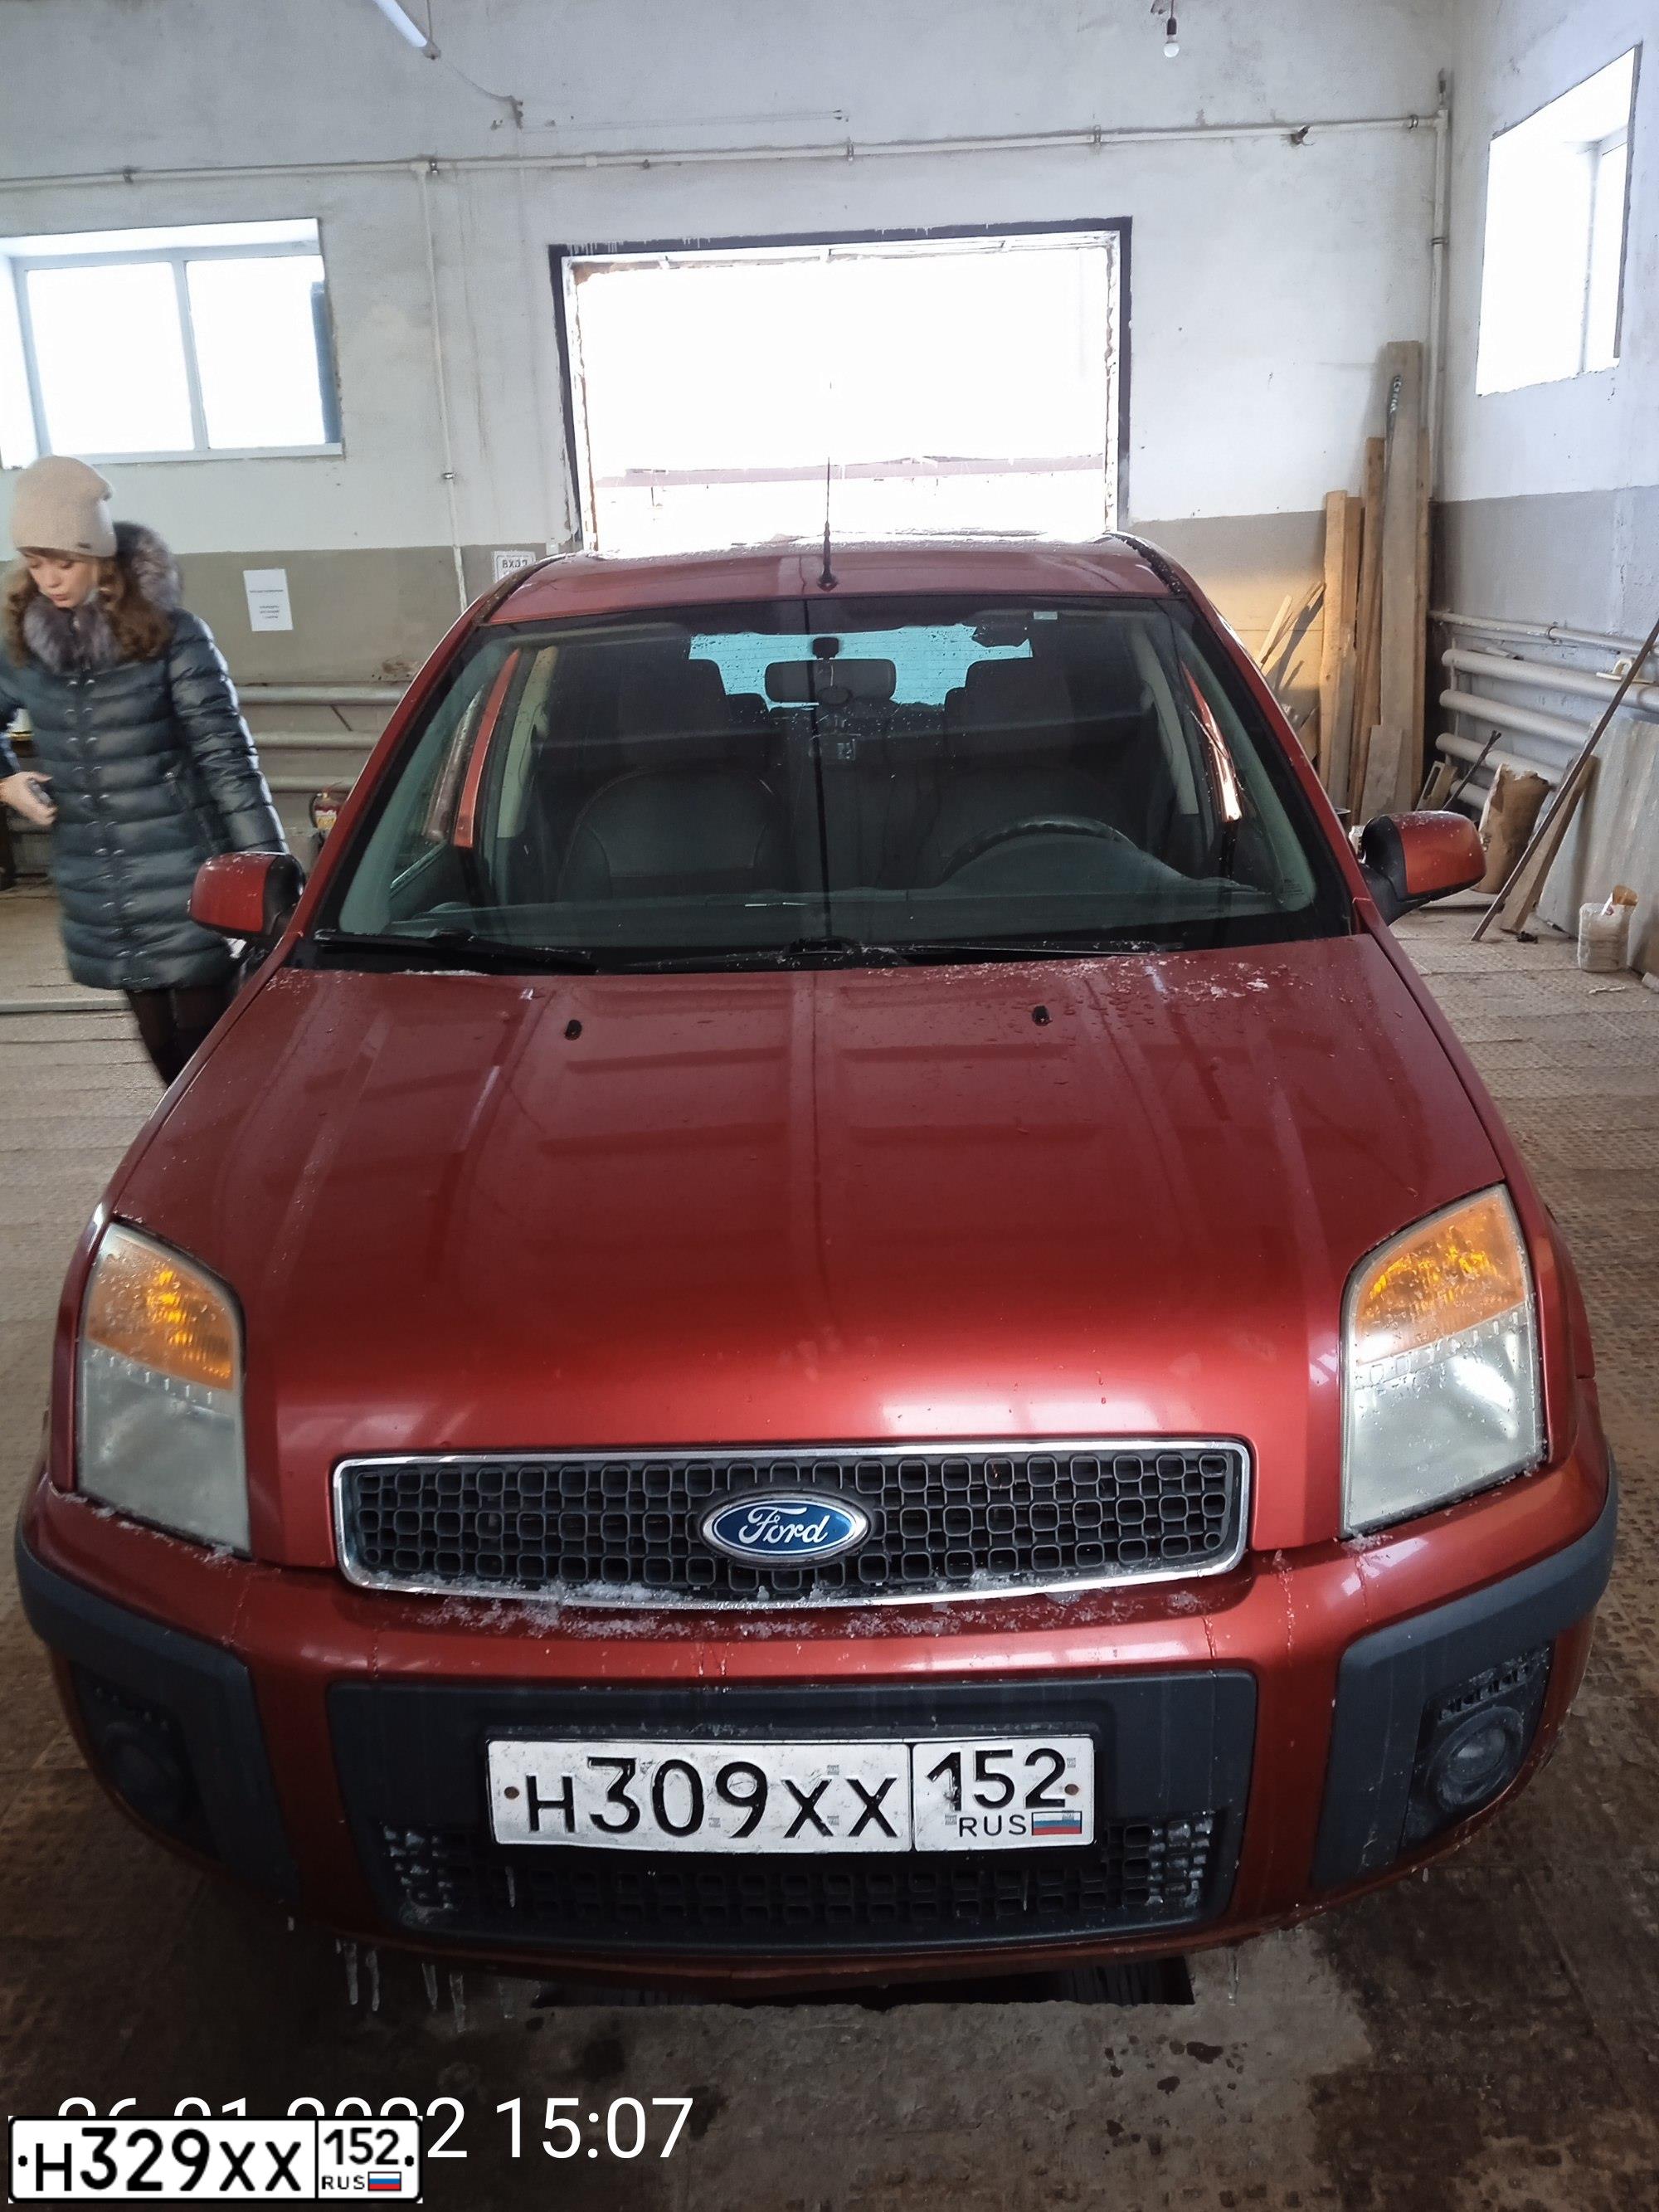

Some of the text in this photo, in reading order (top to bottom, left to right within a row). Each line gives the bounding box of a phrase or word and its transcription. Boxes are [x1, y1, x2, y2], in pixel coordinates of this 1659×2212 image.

[738, 1506, 831, 1544] Ford
[926, 1747, 1067, 1812] 152
[958, 1815, 1028, 1838] RUS
